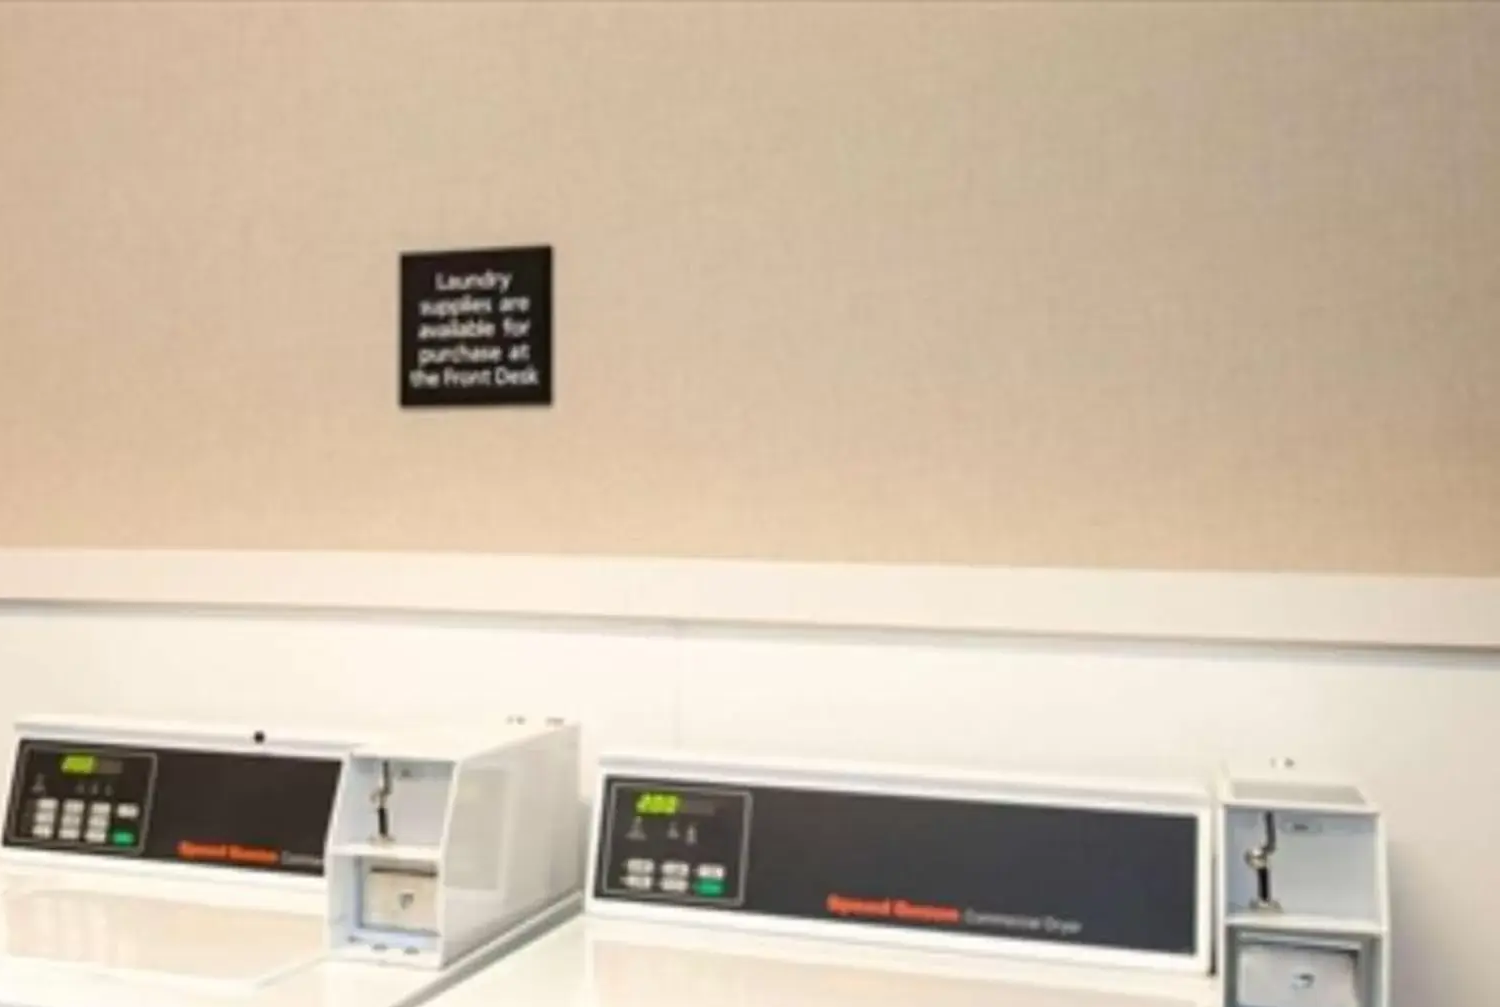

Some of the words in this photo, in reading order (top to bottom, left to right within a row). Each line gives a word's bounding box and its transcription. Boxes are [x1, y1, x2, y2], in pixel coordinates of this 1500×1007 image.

[434, 269, 512, 292] Laundry
[498, 296, 530, 313] are
[417, 318, 496, 340] available
[502, 317, 531, 338] for
[417, 343, 502, 366] purchase
[507, 343, 531, 362] at
[408, 367, 440, 387] the
[443, 366, 492, 387] Front
[494, 365, 540, 386] Desk
